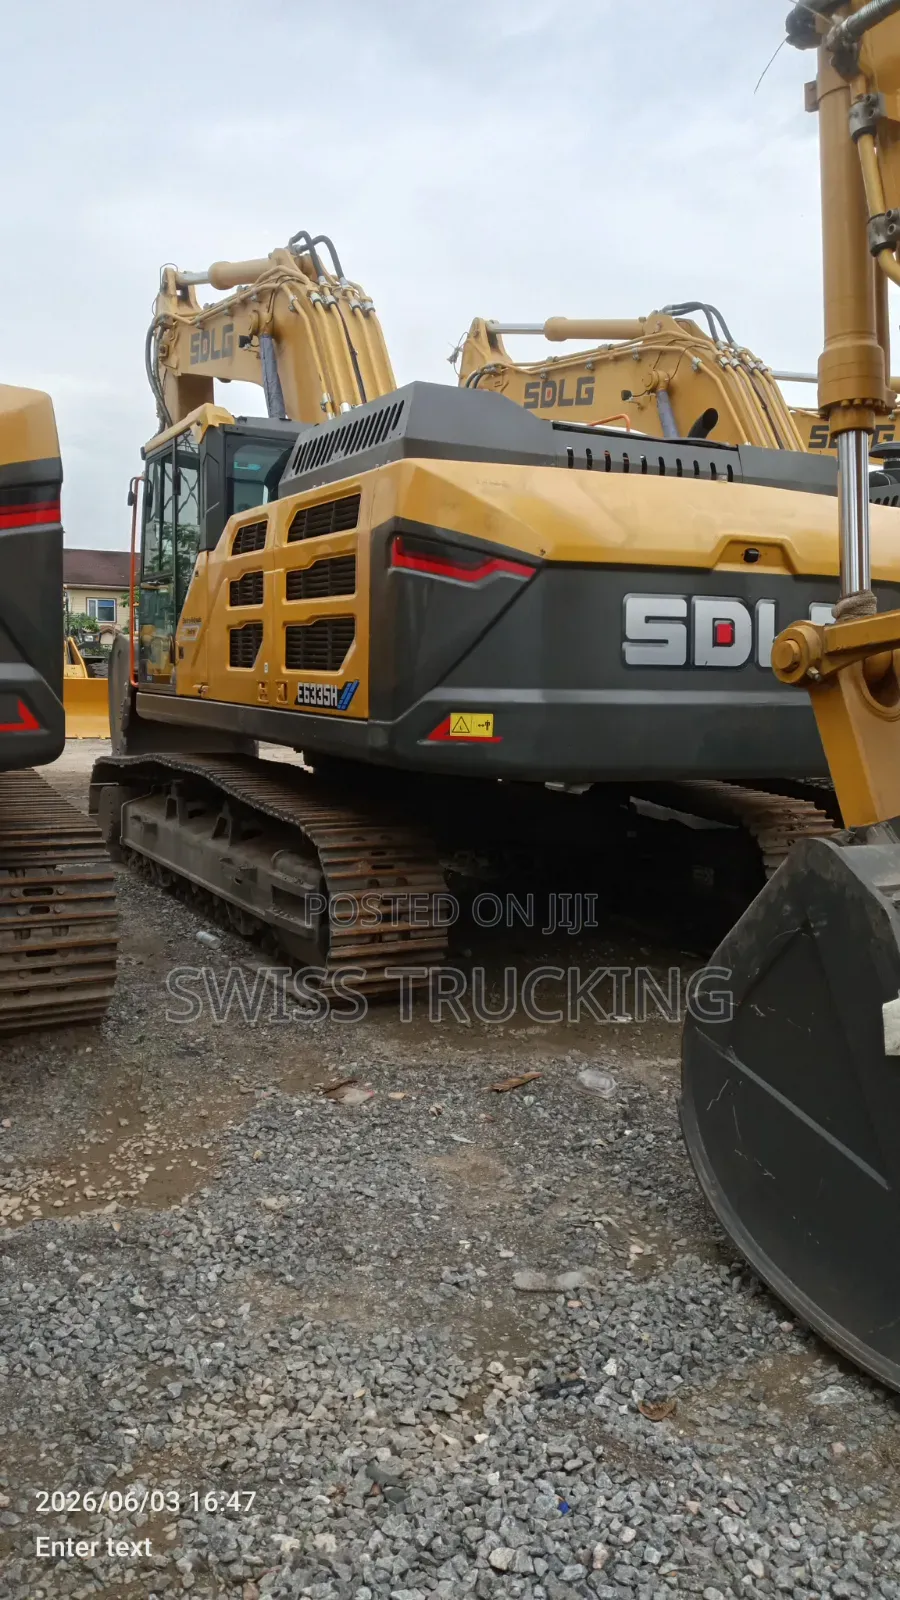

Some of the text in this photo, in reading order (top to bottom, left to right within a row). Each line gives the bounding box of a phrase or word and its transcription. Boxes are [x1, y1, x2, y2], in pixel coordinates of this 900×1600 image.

[190, 323, 234, 365] SDLG
[524, 376, 596, 409] SDLG
[808, 424, 896, 449] SG
[622, 593, 836, 668] SDL
[297, 682, 338, 707] E6335H
